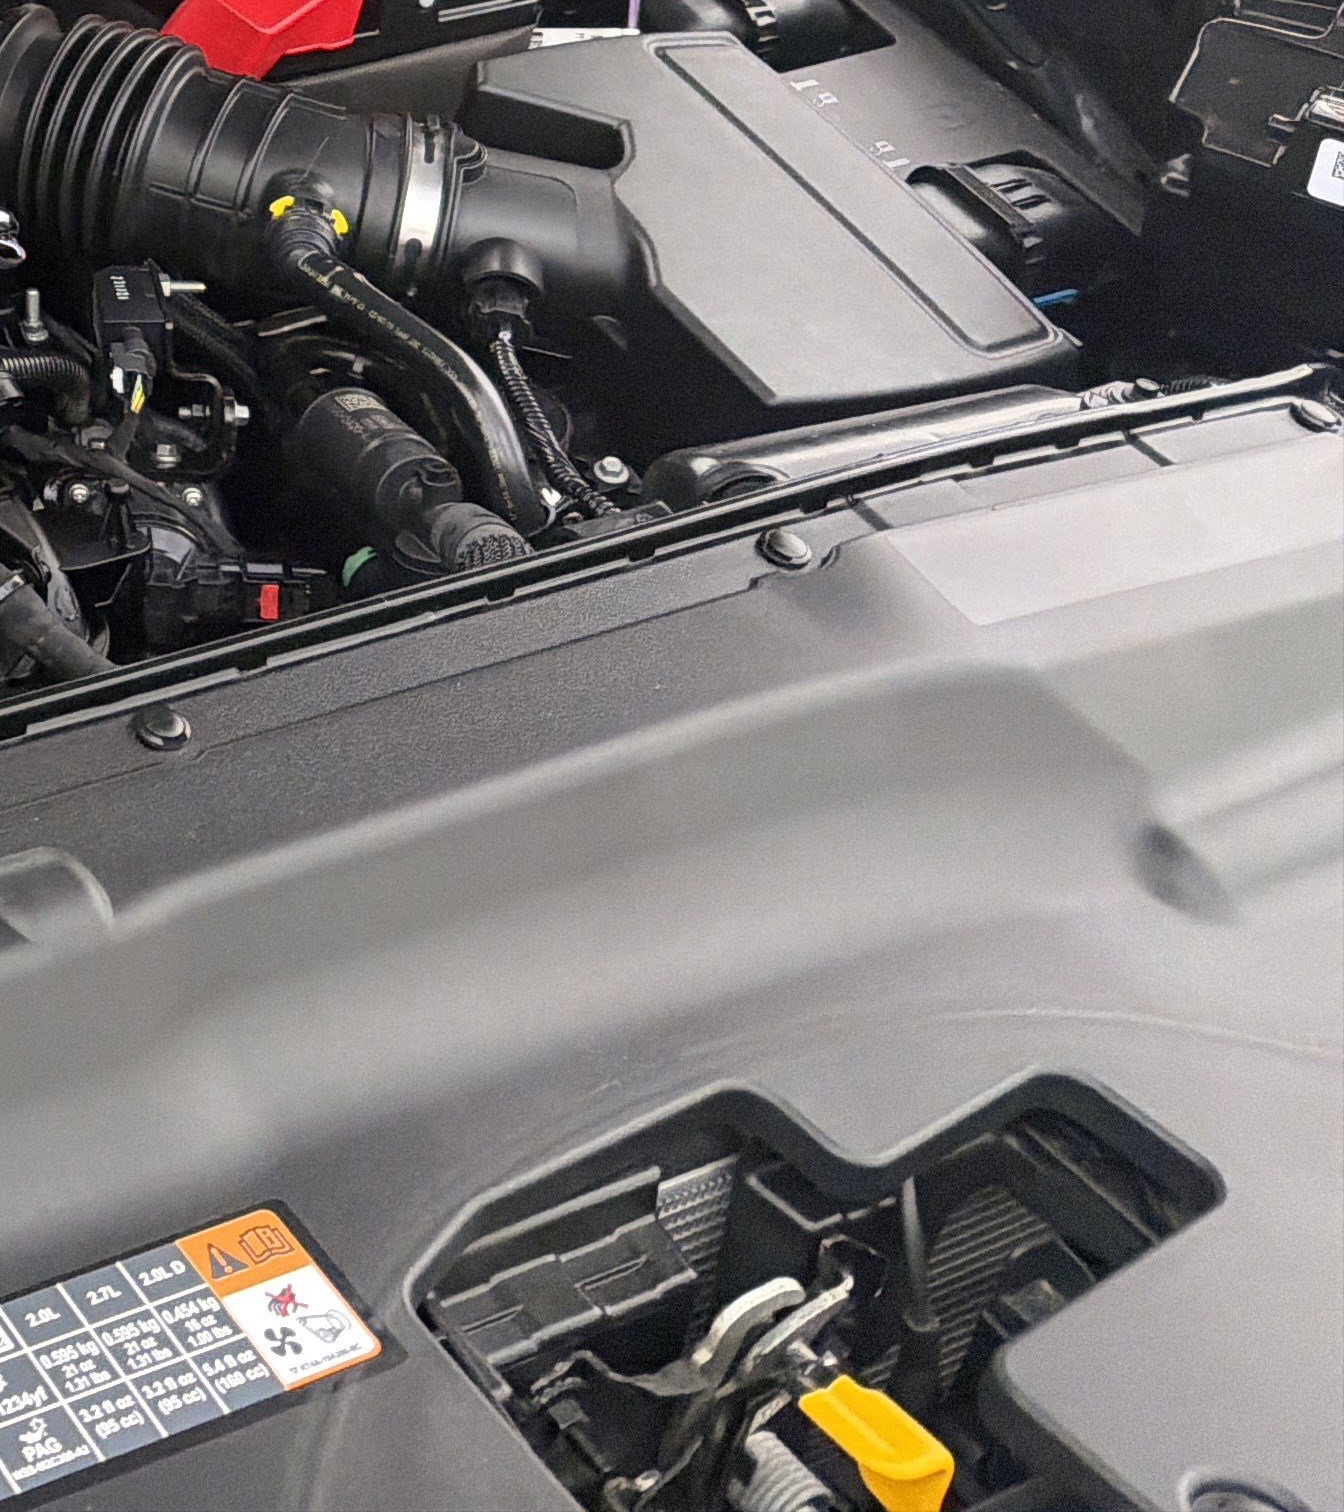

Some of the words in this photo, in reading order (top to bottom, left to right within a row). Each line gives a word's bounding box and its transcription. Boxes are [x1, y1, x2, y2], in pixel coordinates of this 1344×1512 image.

[139, 1267, 171, 1286] 2.0L
[169, 1260, 186, 1276] D
[85, 1284, 122, 1306] 2.7L
[24, 1307, 61, 1329] 2.0L
[161, 1301, 201, 1325] 0.454
[198, 1295, 221, 1315] kg
[200, 1314, 217, 1328] oz
[101, 1323, 141, 1347] 0.595
[138, 1318, 161, 1336] kg
[211, 1325, 233, 1342] lbs
[39, 1344, 80, 1370] 0.595
[76, 1340, 100, 1359] kg
[123, 1343, 140, 1356] 21
[140, 1336, 158, 1350] oz
[127, 1354, 154, 1371] 1.31
[151, 1347, 173, 1365] lbs
[61, 1364, 78, 1379] 21
[79, 1358, 96, 1374] oz
[202, 1359, 227, 1377] 5.4
[238, 1349, 257, 1364] oz
[244, 1364, 271, 1381] cc)
[65, 1376, 91, 1394] 1.31
[88, 1370, 112, 1387] lbs
[141, 1382, 166, 1401] 3.2
[178, 1372, 198, 1387] oz
[79, 1404, 103, 1424] 3.2
[115, 1394, 135, 1409] oz
[158, 1396, 182, 1416] (95
[179, 1387, 207, 1407] cc)
[95, 1418, 122, 1440] (95
[119, 1411, 145, 1430] cc)
[21, 1436, 62, 1463] PAG
